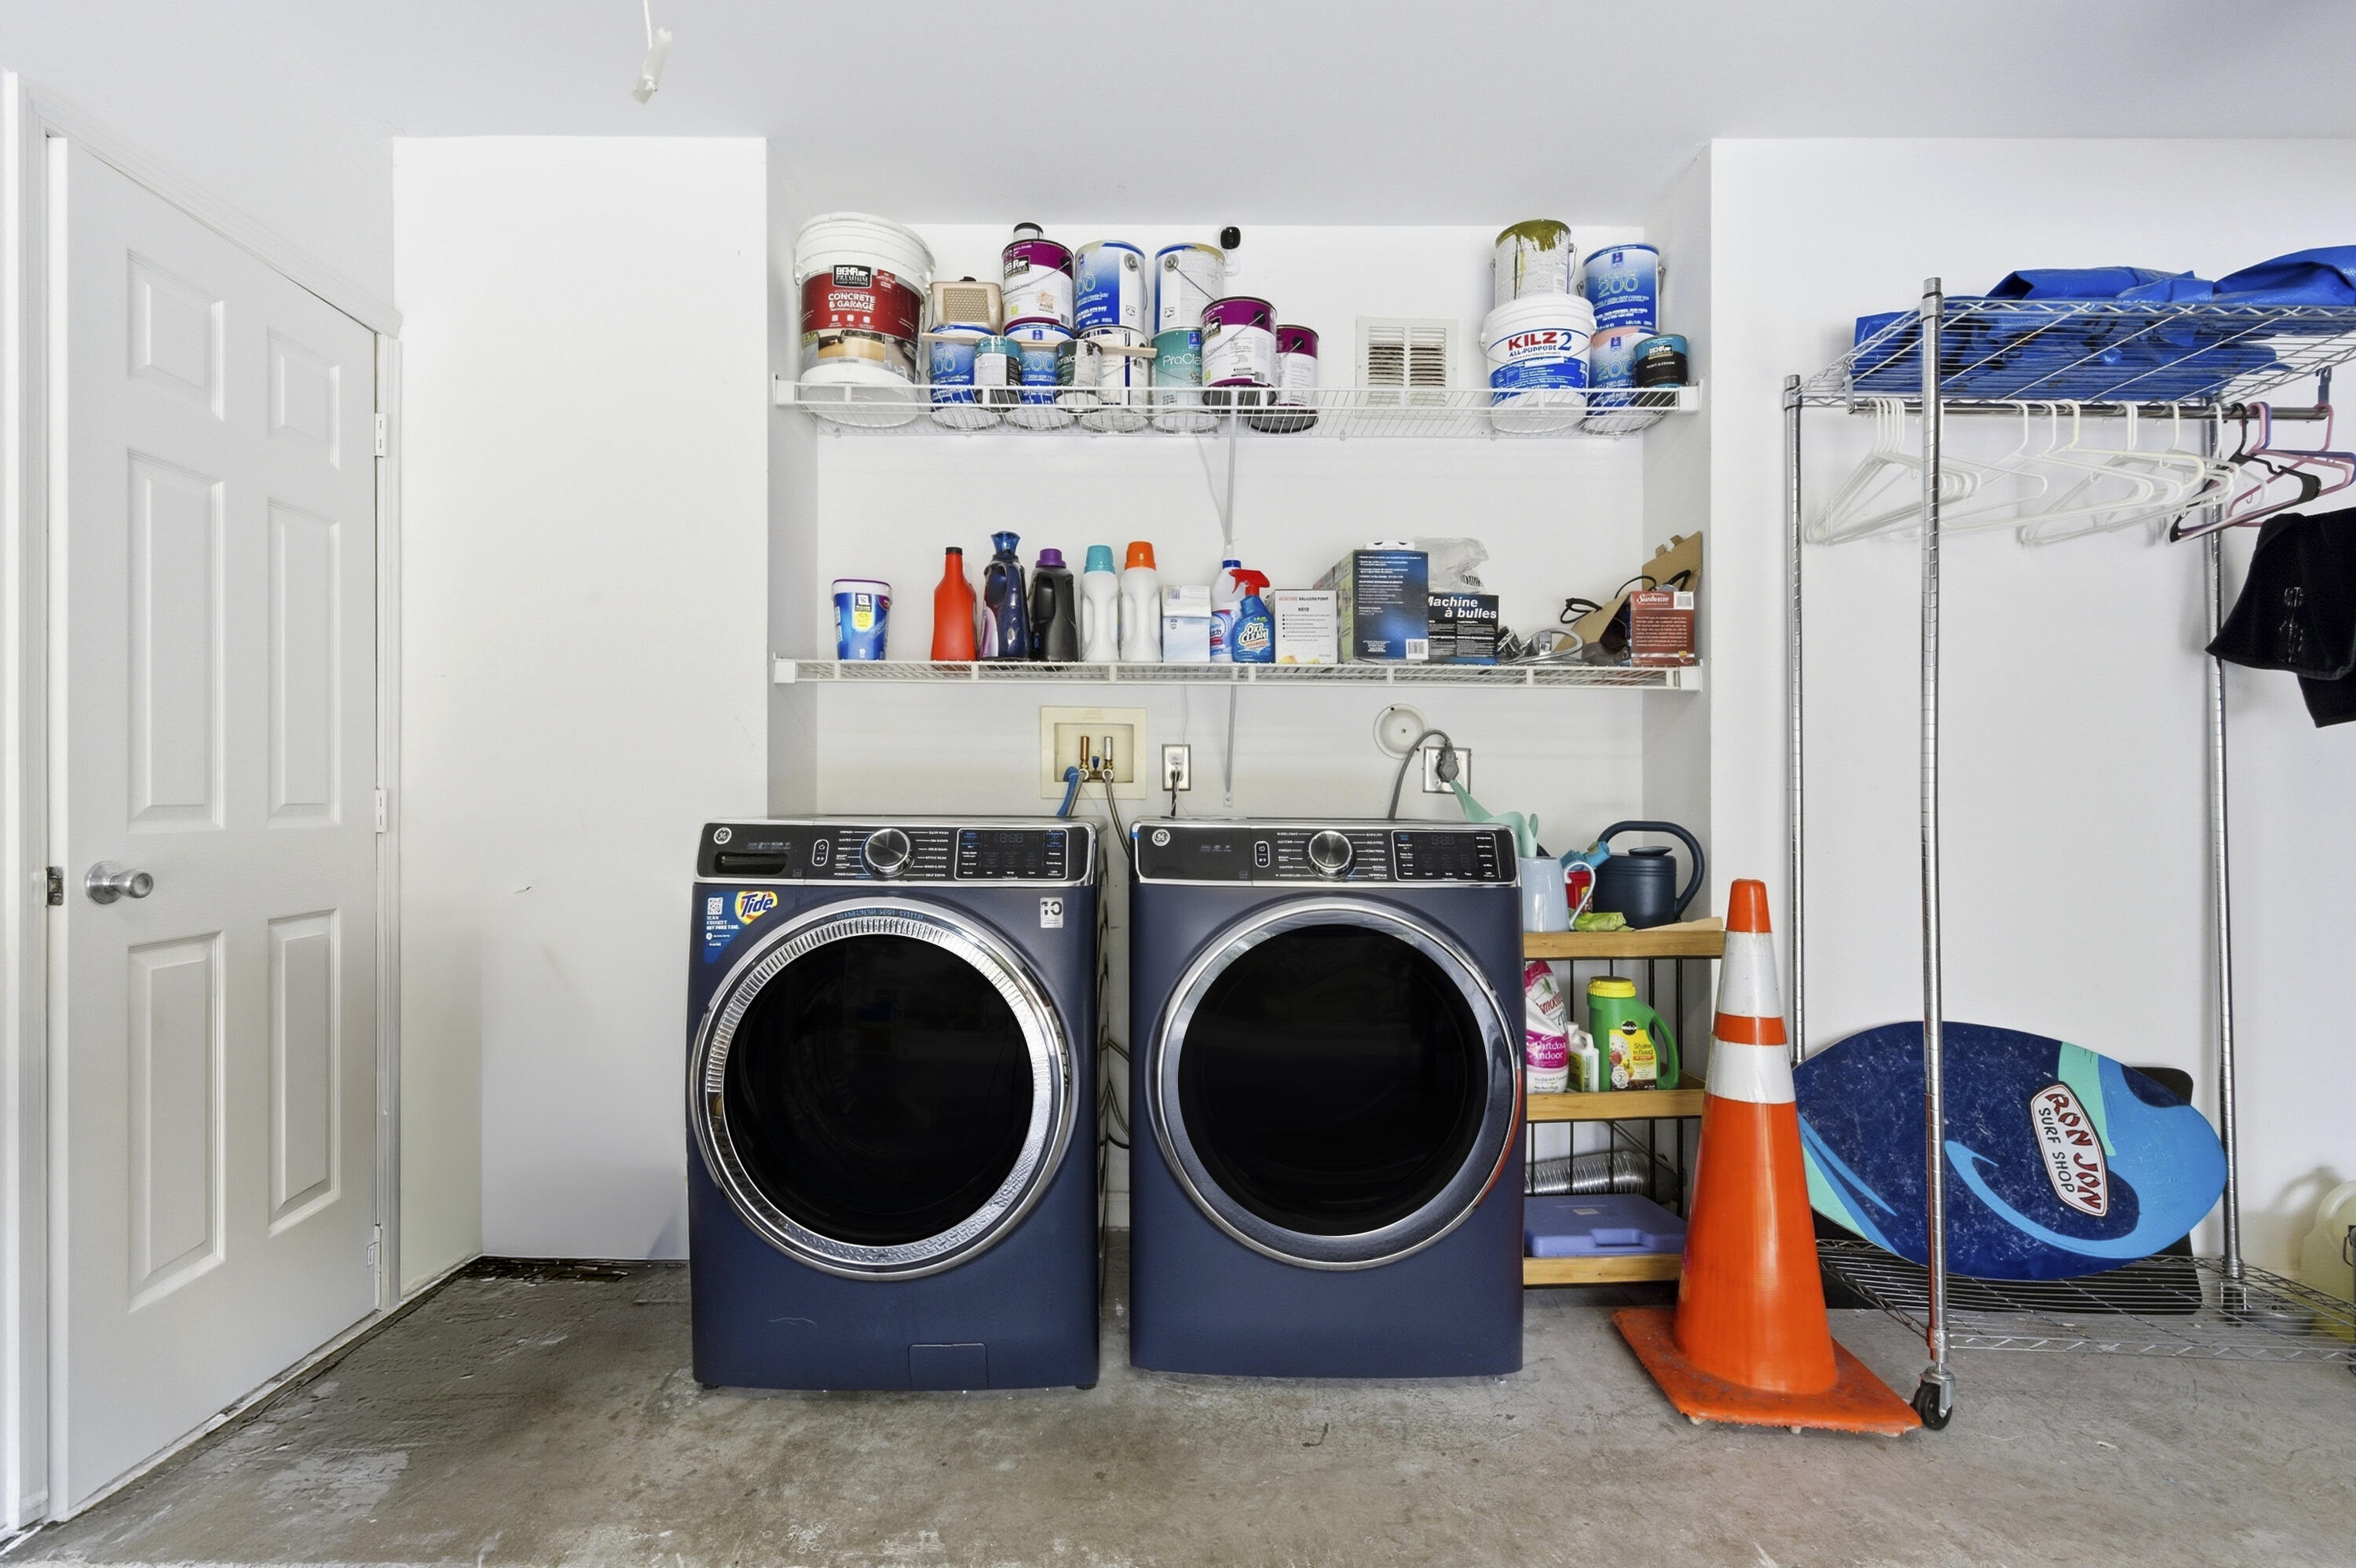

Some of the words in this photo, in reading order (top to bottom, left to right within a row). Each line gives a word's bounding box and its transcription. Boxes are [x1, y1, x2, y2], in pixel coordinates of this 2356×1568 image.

[836, 267, 859, 276] BEHR
[1597, 276, 1638, 298] 200
[828, 293, 876, 304] CONCRETE
[836, 300, 875, 311] GARAGE
[1508, 331, 1557, 351] KILZ
[1557, 331, 1572, 352] 2
[1019, 353, 1056, 373] 200
[1162, 353, 1202, 367] ProCla
[1445, 608, 1453, 618] à
[1457, 609, 1497, 619] bulles
[741, 894, 774, 918] Tide
[2039, 1107, 2062, 1144] SURF
[2052, 1151, 2076, 1193] SHOP
[2044, 1093, 2094, 1146] RON
[2073, 1152, 2102, 1210] JON
